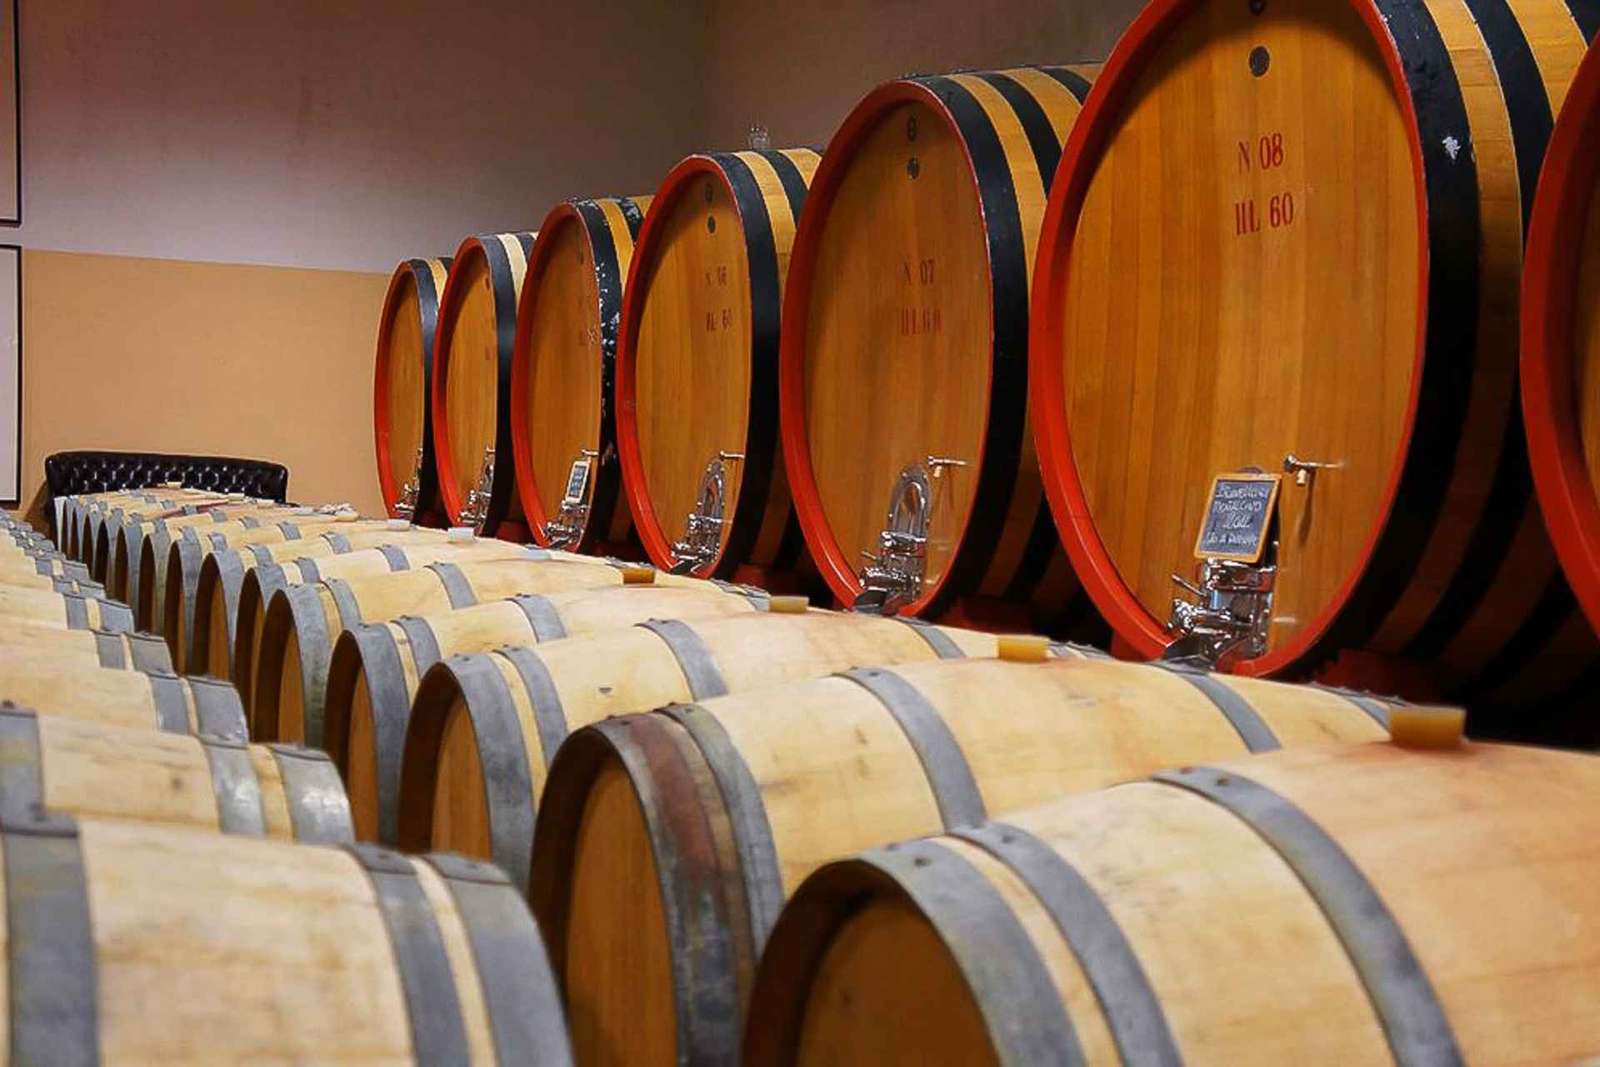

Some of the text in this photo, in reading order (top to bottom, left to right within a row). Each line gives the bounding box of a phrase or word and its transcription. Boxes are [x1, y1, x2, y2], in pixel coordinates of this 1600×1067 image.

[1238, 132, 1284, 174] N 08
[1269, 192, 1294, 228] 60
